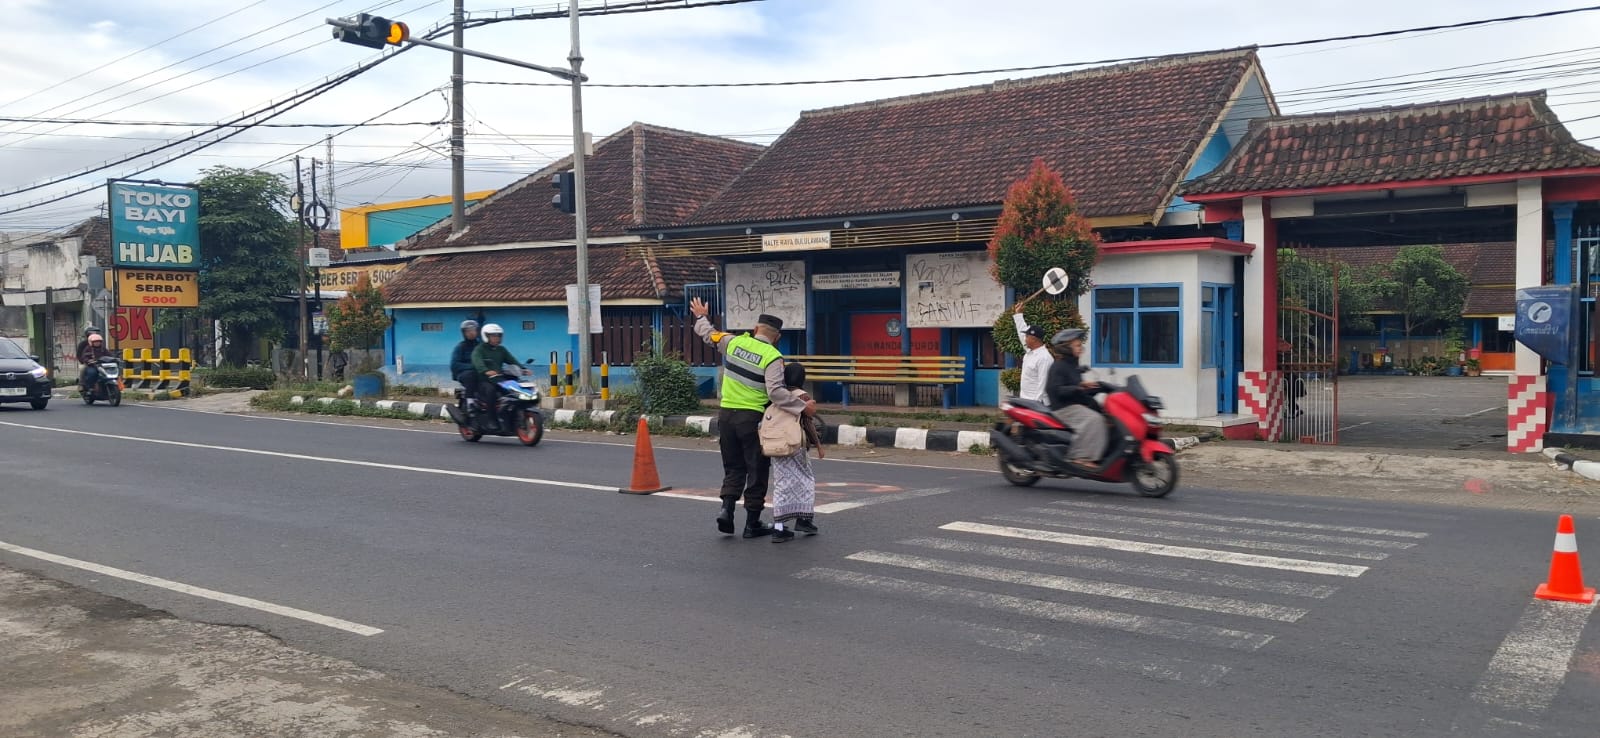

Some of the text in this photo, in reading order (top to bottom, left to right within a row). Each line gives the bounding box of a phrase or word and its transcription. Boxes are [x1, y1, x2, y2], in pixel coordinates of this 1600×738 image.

[118, 190, 192, 208] TOKO
[125, 206, 186, 223] BAYI
[763, 239, 780, 247] HALTE
[119, 243, 193, 264] HIJAB
[125, 272, 191, 281] PERABOT
[135, 284, 183, 293] SERBA
[142, 296, 177, 304] 5000
[109, 308, 153, 341] 5K
[734, 347, 761, 364] POLISI
